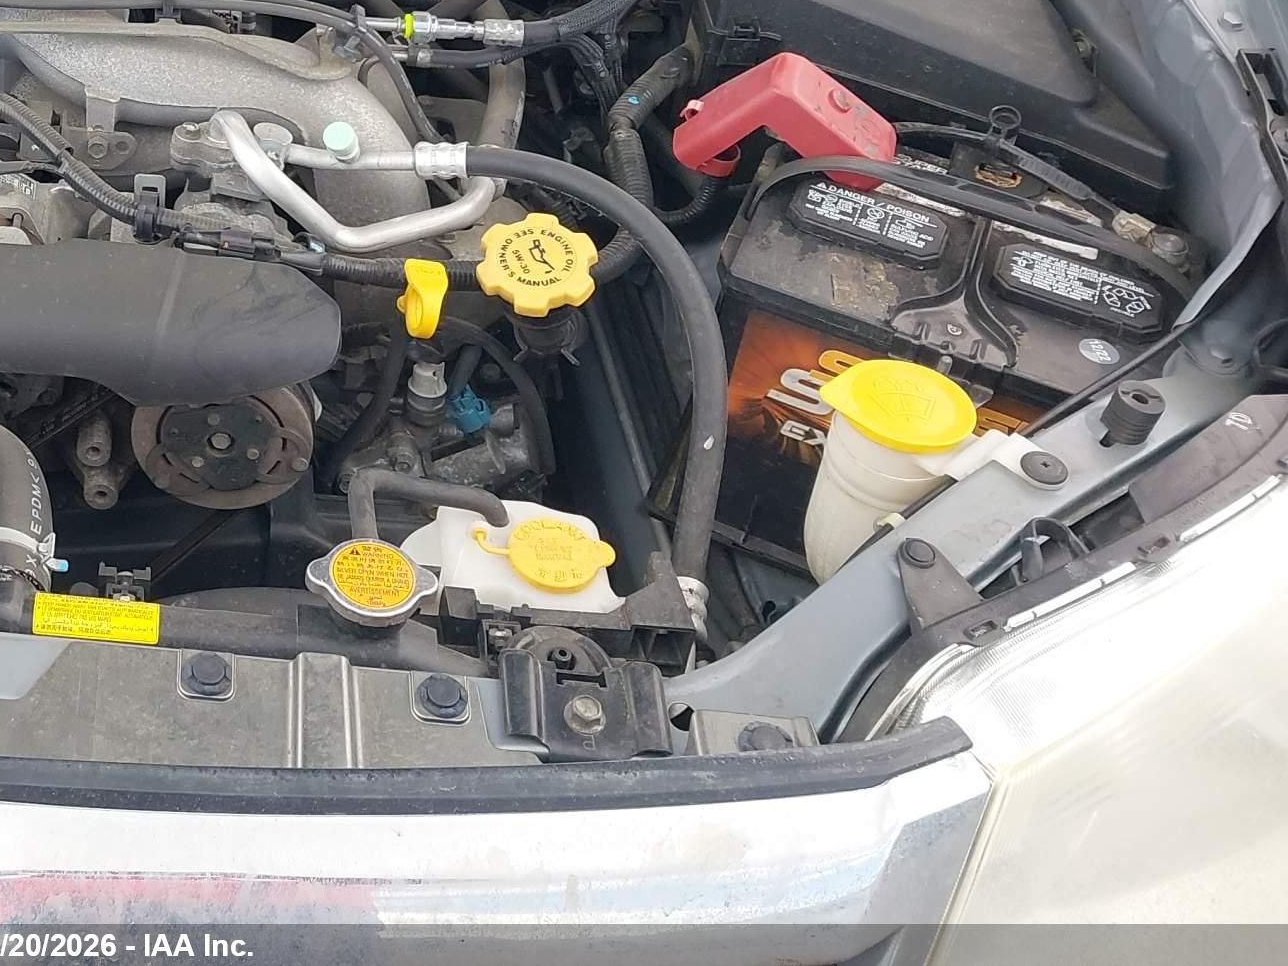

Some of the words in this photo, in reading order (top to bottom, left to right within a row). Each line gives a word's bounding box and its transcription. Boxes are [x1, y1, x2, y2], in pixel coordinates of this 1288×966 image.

[826, 186, 876, 204] DANGER
[886, 204, 930, 223] POISON
[513, 228, 534, 239] SEE
[512, 249, 530, 274] 5W-30
[540, 229, 574, 256] ENGINE
[561, 258, 574, 272] OIL
[516, 275, 562, 287] MANUAL
[1089, 340, 1112, 362] 12/22
[349, 586, 400, 597] AVERTISSEMENT
